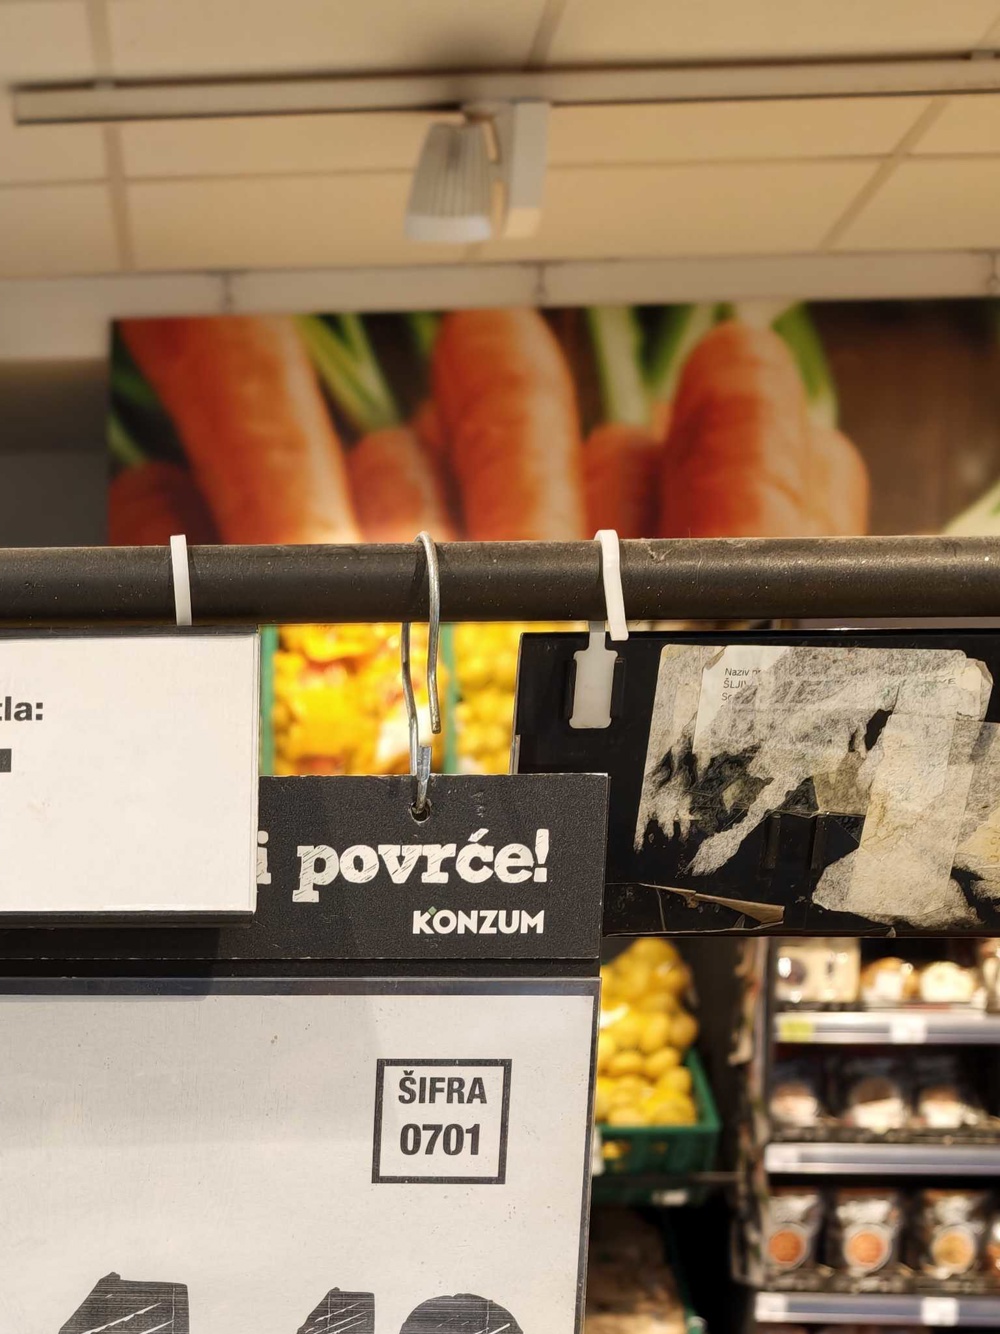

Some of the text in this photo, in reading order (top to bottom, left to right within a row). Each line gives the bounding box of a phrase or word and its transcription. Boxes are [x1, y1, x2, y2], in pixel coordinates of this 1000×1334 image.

[292, 828, 550, 903] povrće!
[412, 908, 545, 934] KONZUM
[398, 1070, 487, 1104] ŠIFRA
[399, 1123, 480, 1156] 0701
